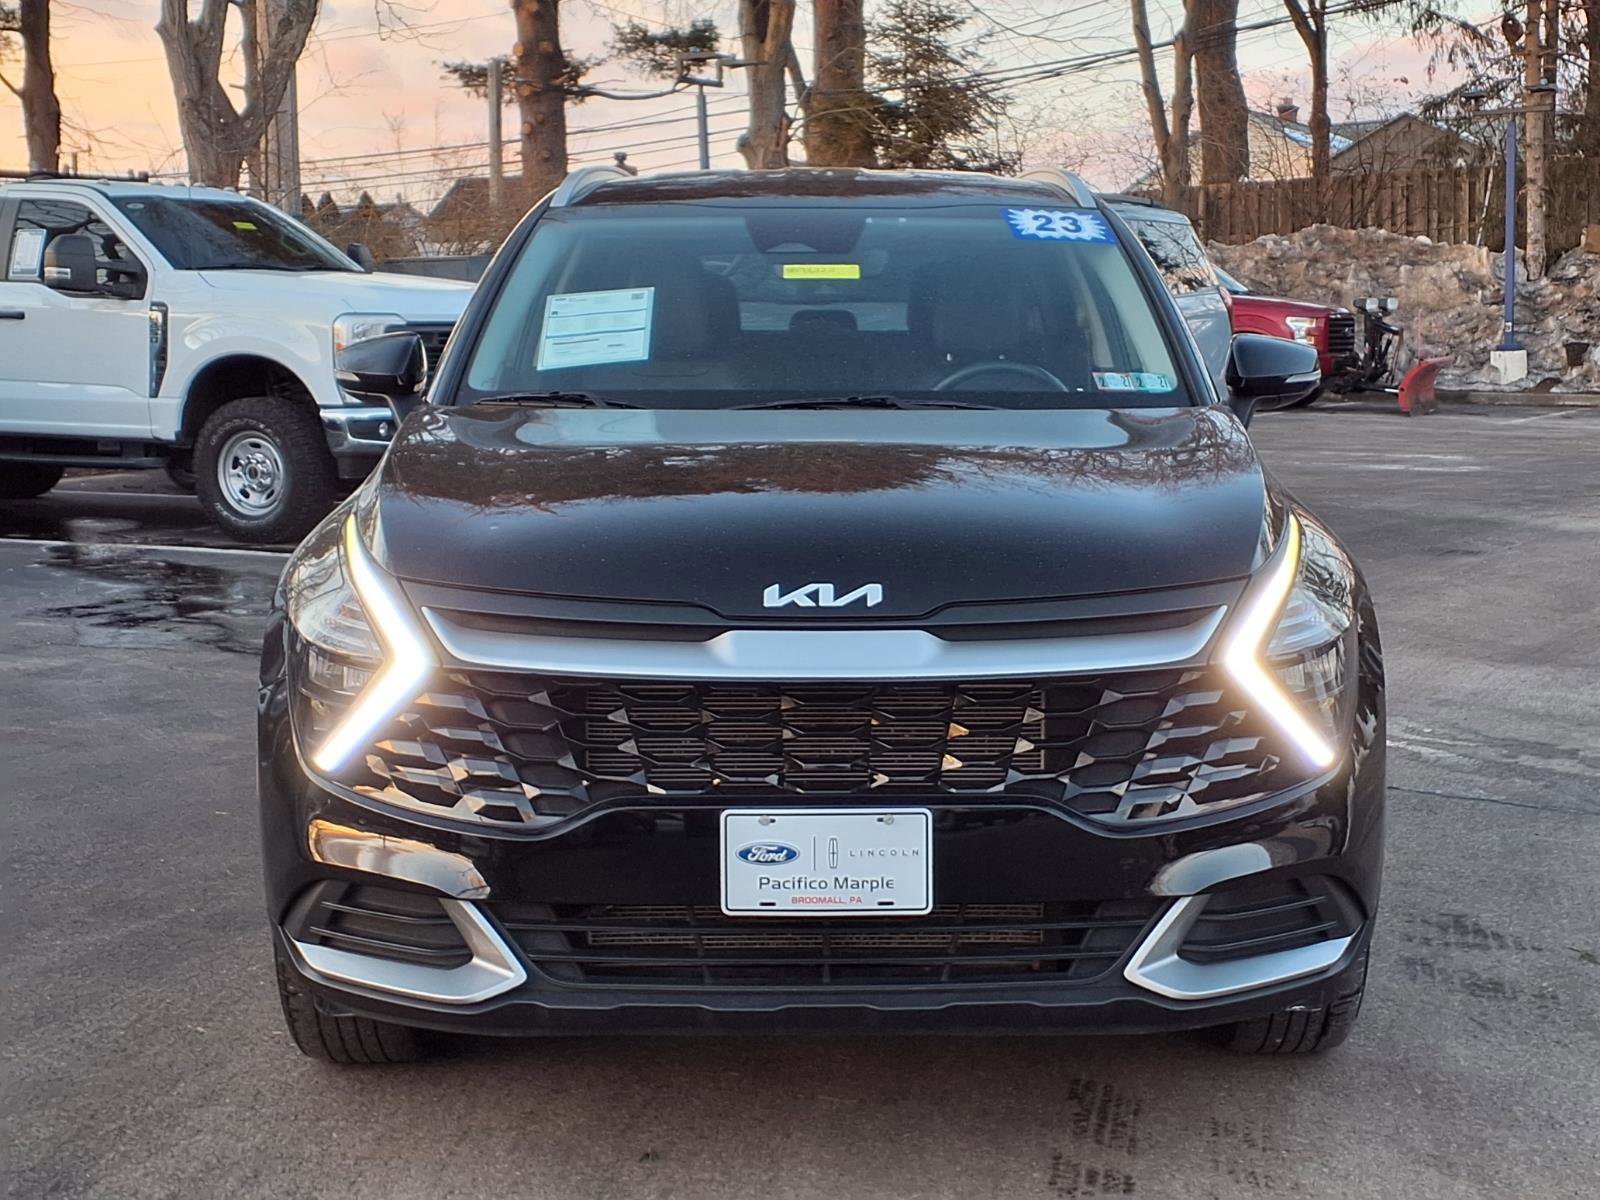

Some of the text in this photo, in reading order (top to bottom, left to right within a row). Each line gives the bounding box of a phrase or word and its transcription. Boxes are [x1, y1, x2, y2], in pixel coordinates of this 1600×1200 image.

[1032, 214, 1082, 233] 23
[763, 583, 883, 607] KIA
[747, 845, 788, 863] Ford
[758, 876, 895, 892] Pacifico Marple
[791, 896, 863, 905] BROOMALL, PA
